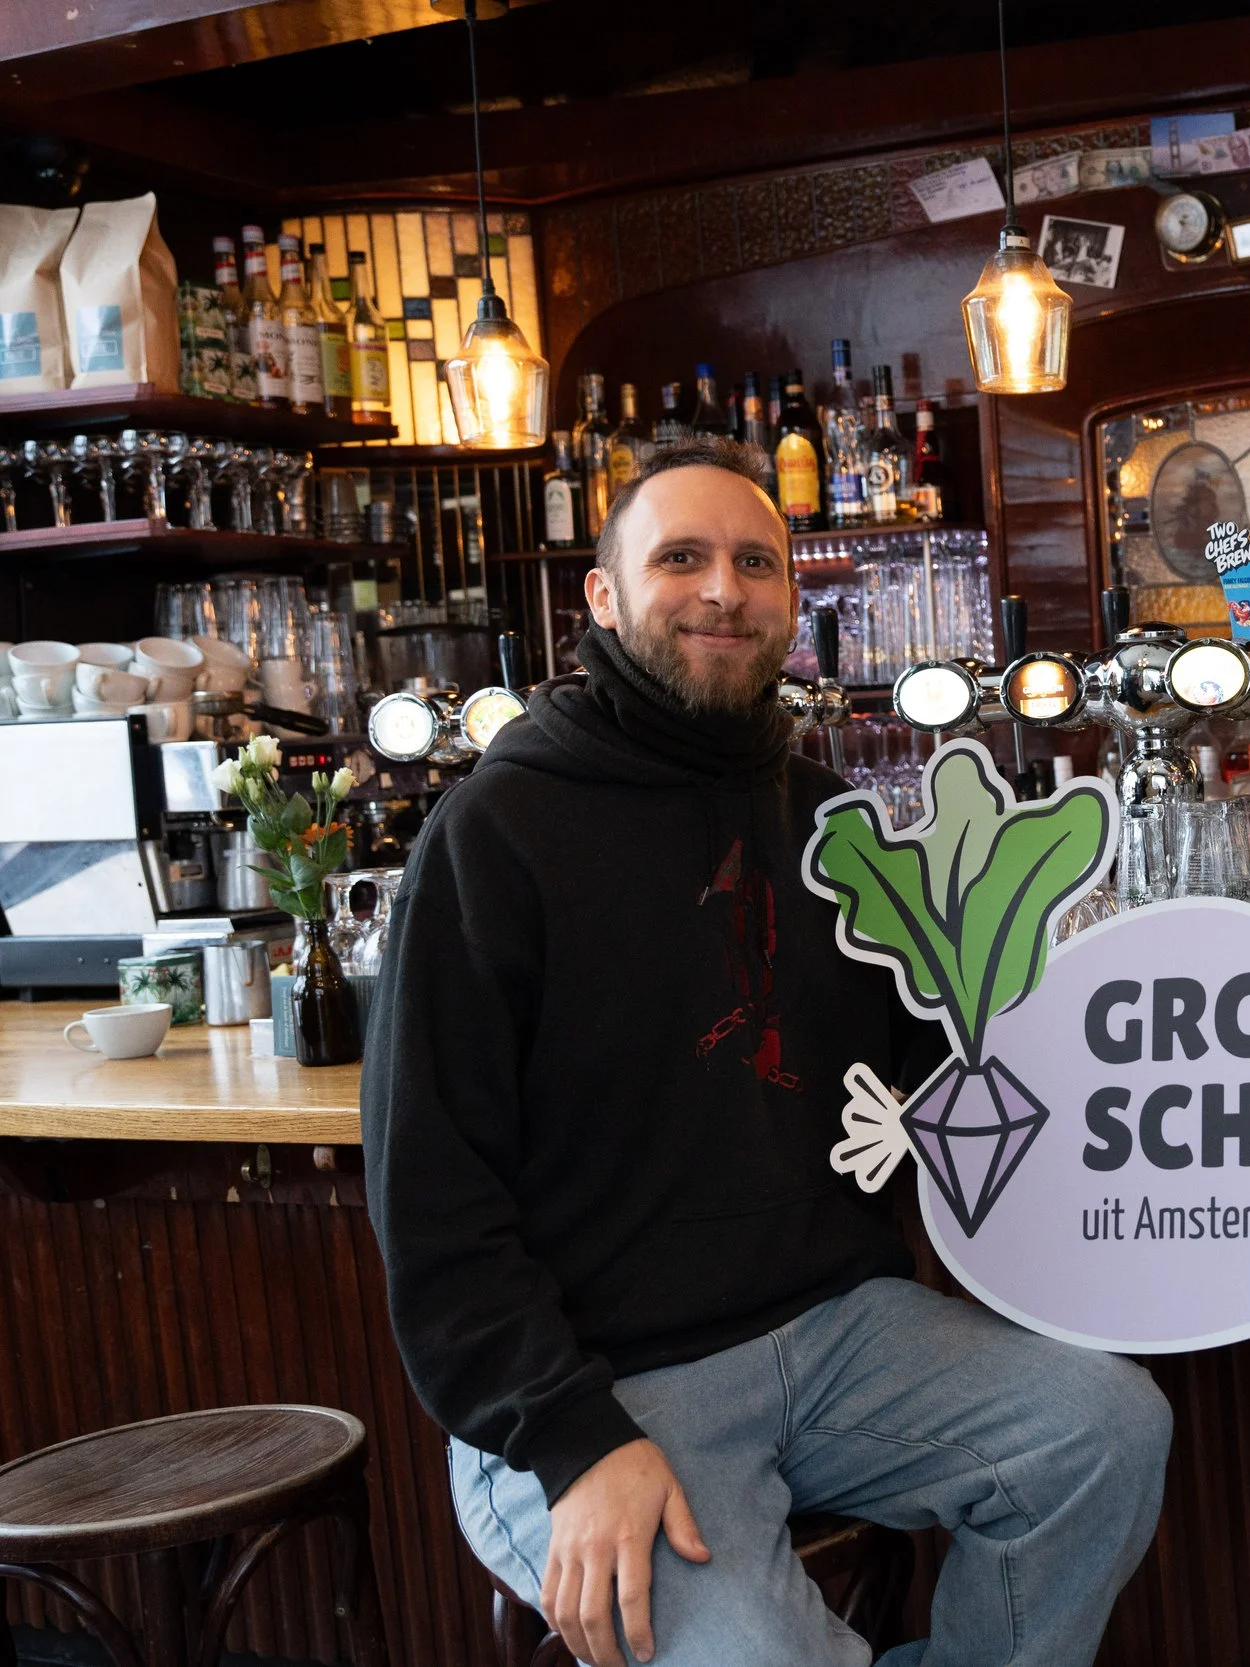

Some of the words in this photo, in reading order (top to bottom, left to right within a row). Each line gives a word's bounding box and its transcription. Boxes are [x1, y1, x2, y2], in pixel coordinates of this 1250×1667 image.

[1205, 529, 1249, 560] CHEFS
[1206, 521, 1235, 540] TWO
[1083, 1196, 1125, 1241] uit
